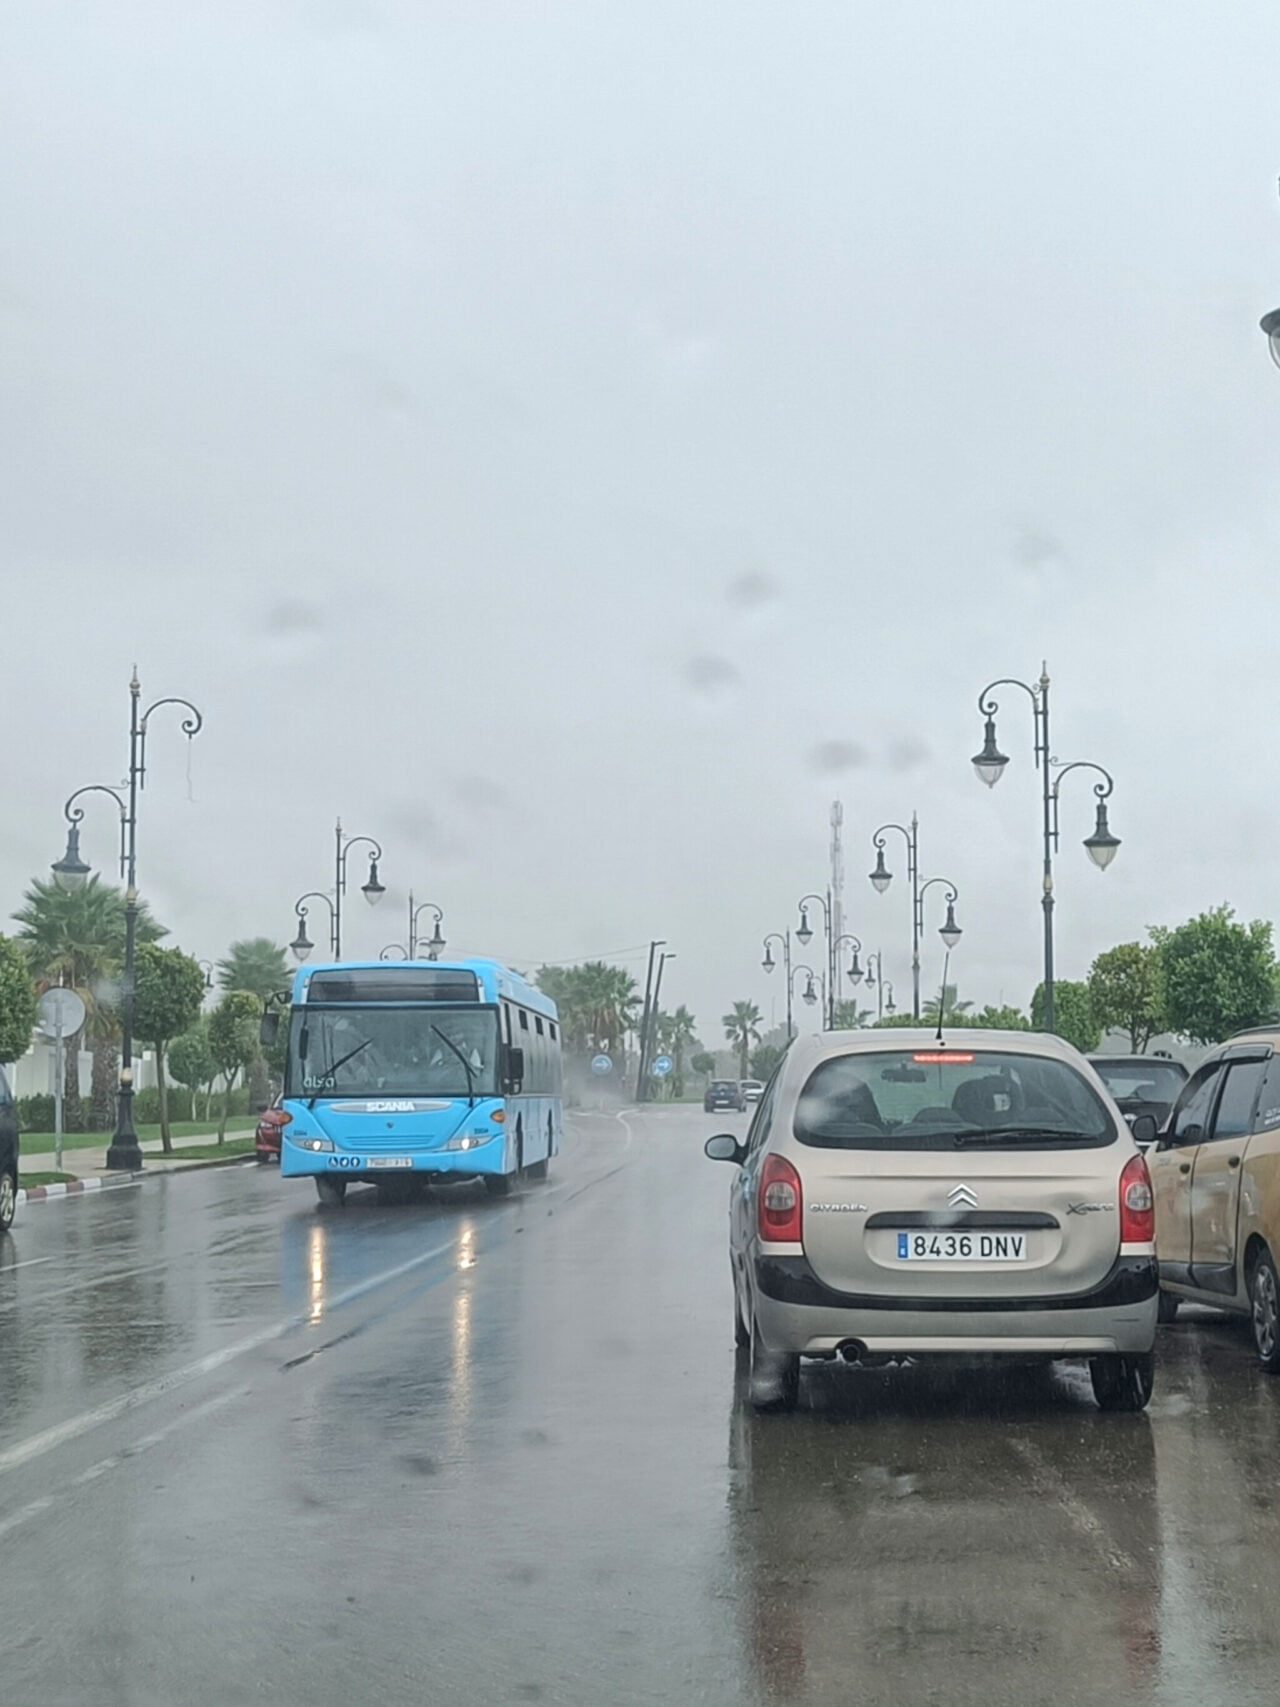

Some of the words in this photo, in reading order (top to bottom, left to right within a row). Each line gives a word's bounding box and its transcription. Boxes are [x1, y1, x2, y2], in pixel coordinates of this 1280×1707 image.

[366, 1101, 416, 1112] SCANIA
[914, 1235, 972, 1257] 8436
[980, 1236, 1023, 1257] DNV
